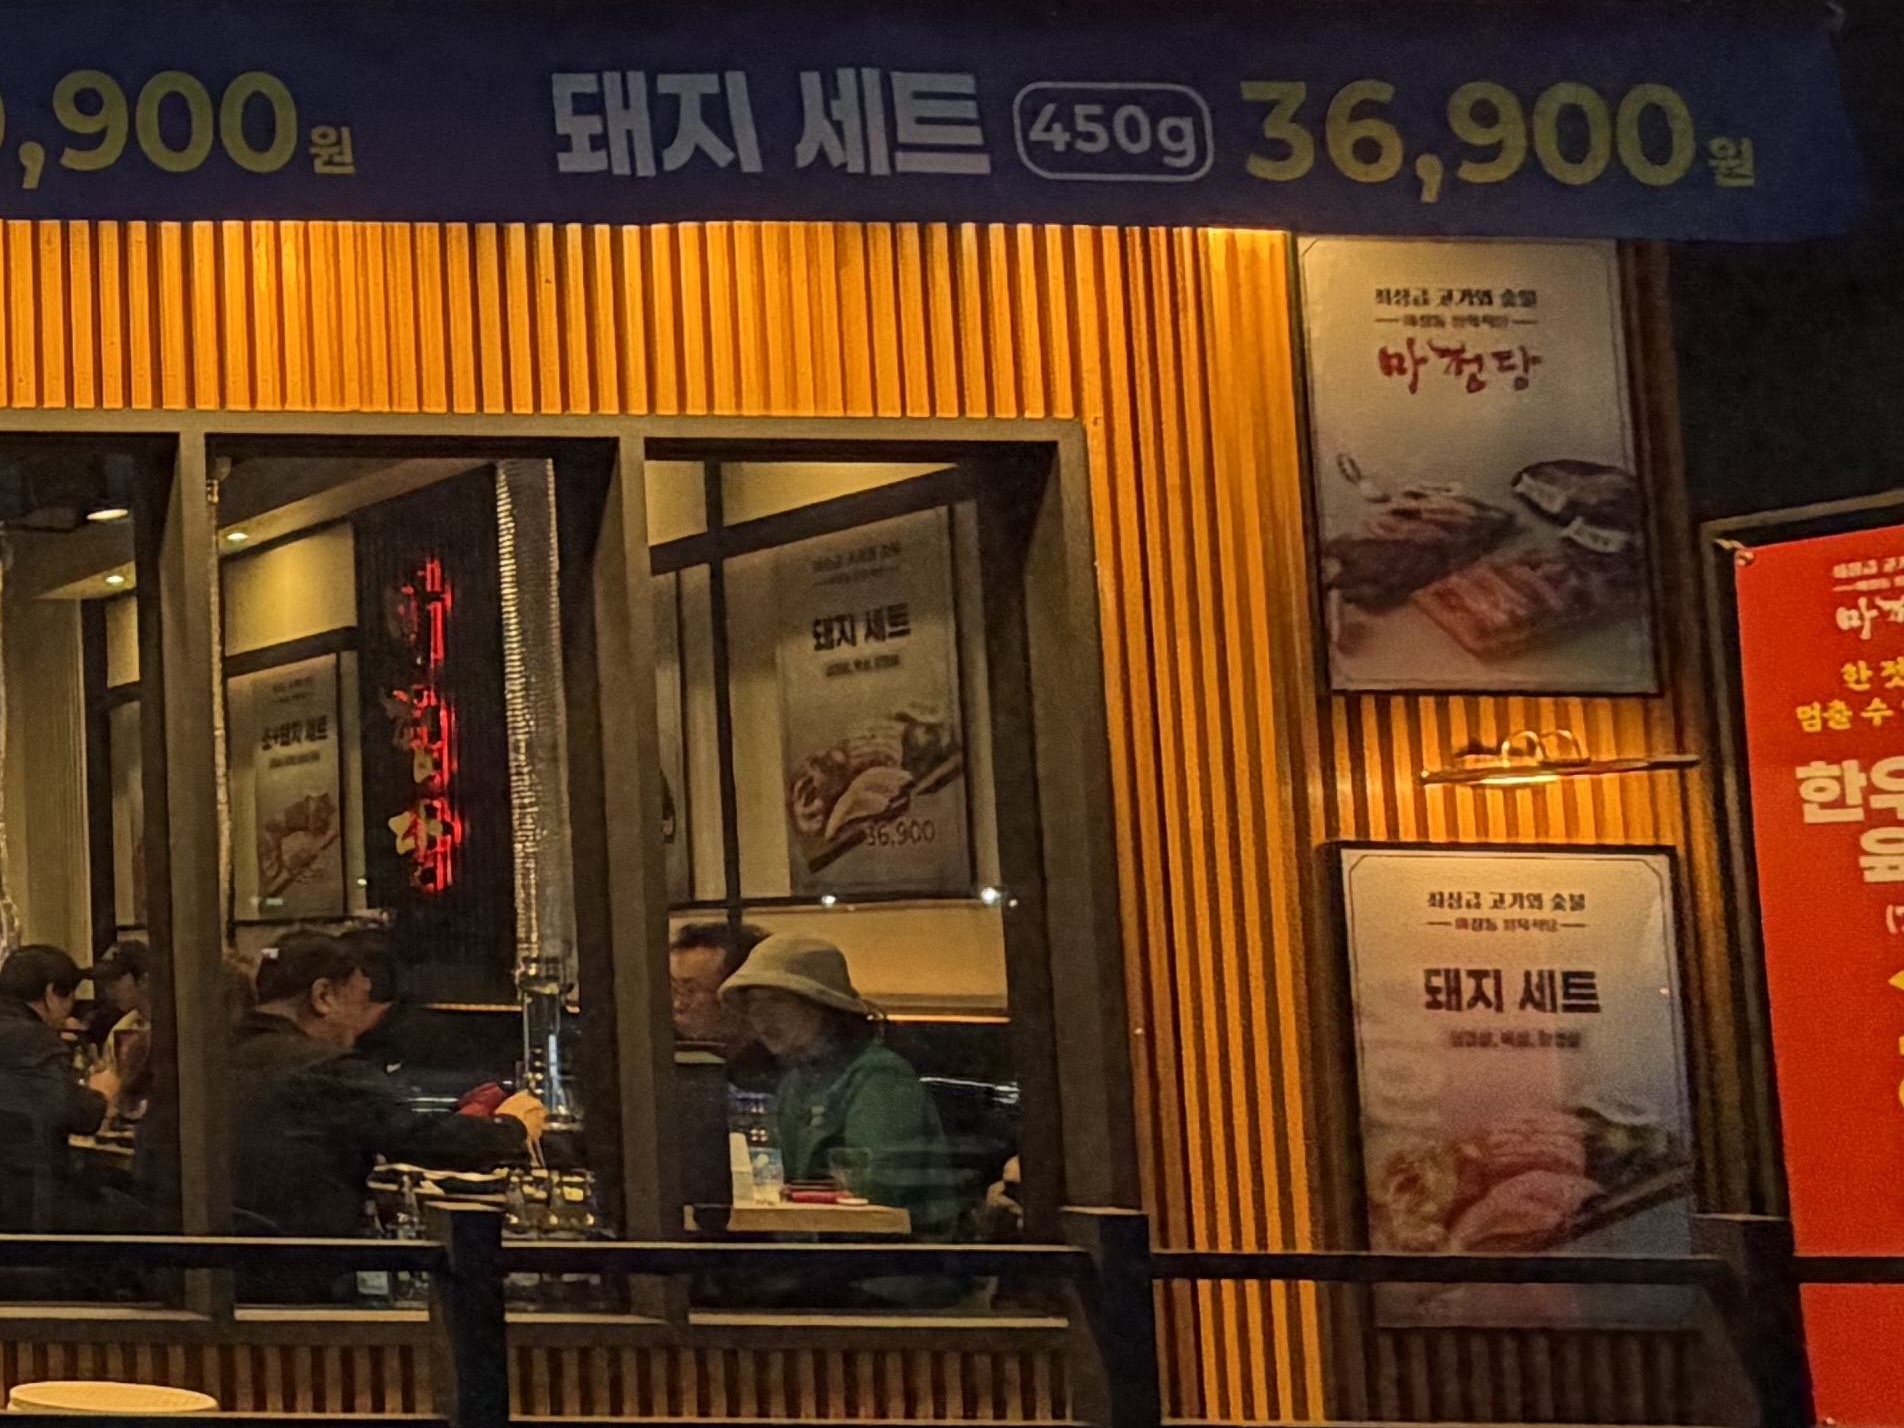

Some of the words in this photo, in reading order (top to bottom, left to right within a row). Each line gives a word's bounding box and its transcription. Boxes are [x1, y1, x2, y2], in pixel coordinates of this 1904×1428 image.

[553, 68, 762, 177] 돼지
[794, 67, 991, 176] 세트
[1027, 104, 1196, 170] 450g
[1860, 697, 1894, 726] 수
[1424, 968, 1504, 1013] 돼지
[1519, 969, 1601, 1013] 세트
